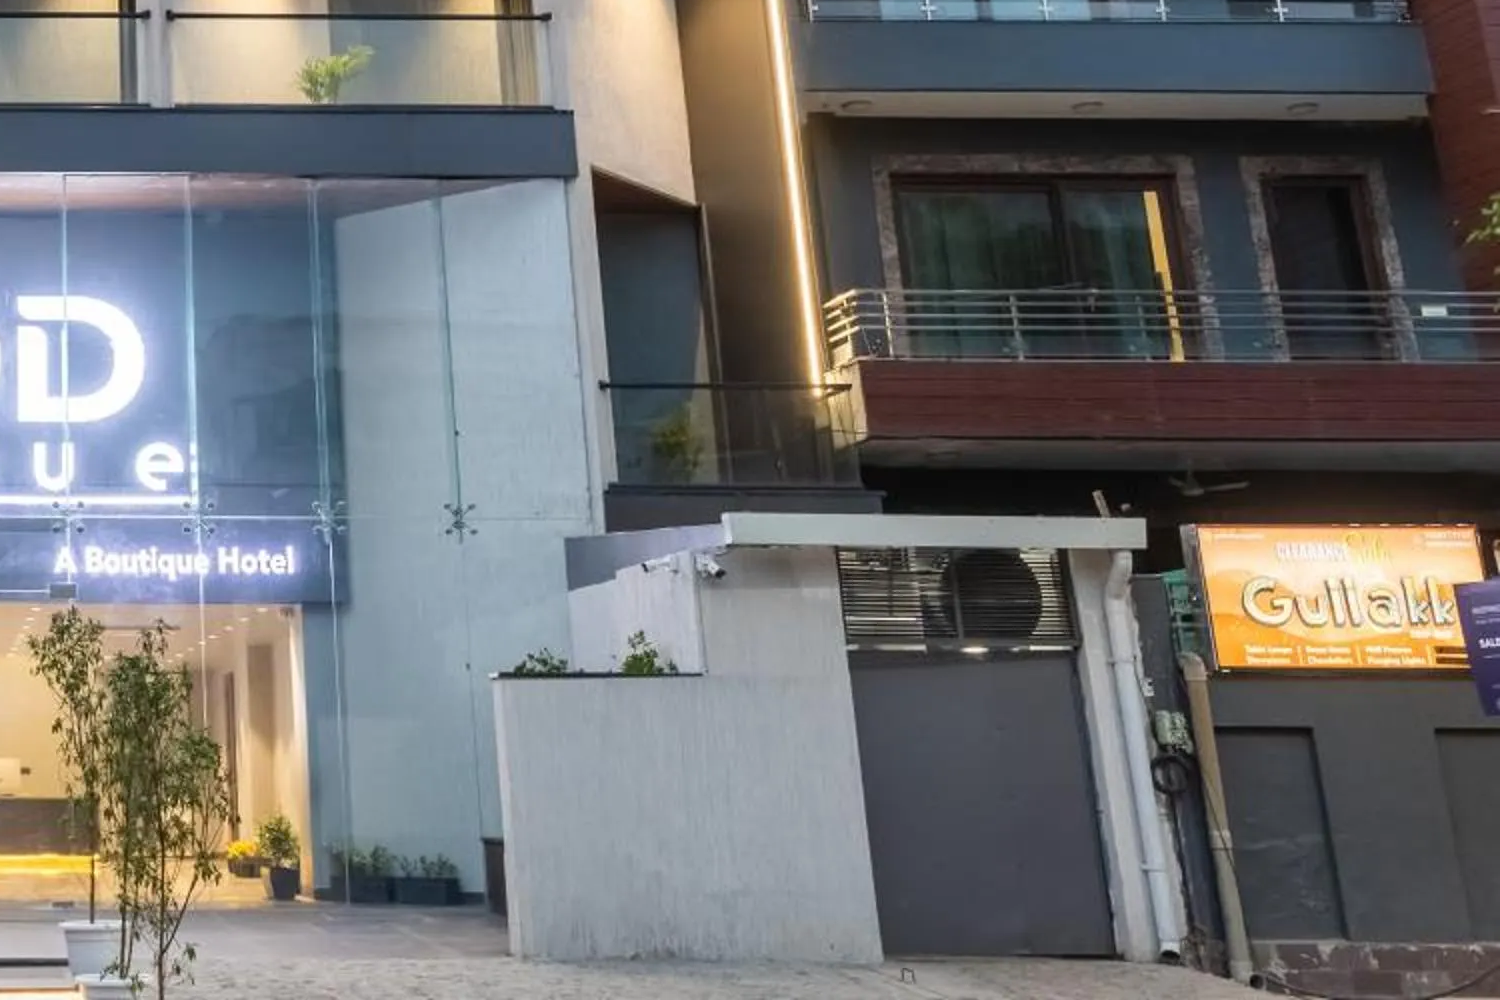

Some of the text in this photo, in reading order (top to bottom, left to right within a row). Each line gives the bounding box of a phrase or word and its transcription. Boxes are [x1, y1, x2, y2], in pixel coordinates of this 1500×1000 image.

[53, 545, 295, 581] A Boutique Hotel
[1241, 575, 1457, 628] Gullakk
